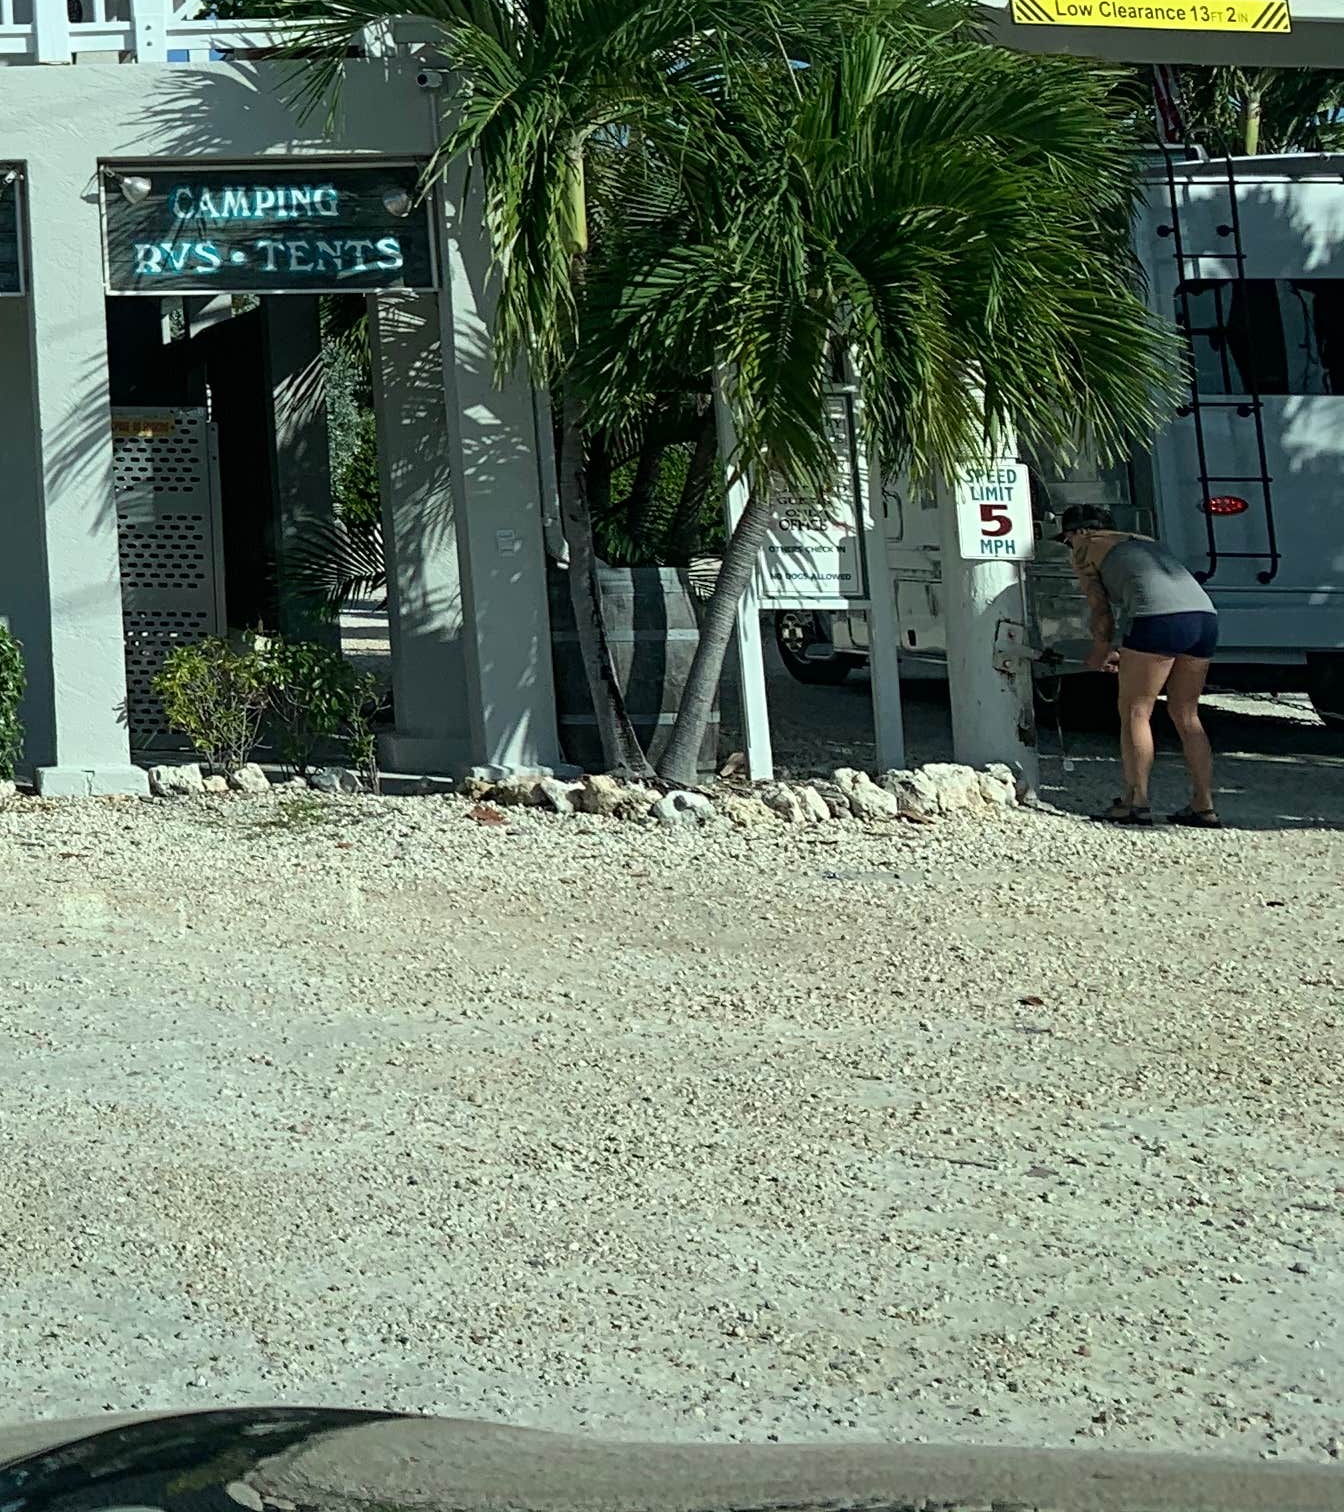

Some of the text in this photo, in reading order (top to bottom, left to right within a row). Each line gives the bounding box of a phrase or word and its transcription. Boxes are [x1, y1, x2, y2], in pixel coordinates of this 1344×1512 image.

[1055, 0, 1093, 17] Low
[1098, 1, 1186, 21] Clearance
[172, 183, 340, 219] CAMPING
[133, 238, 404, 274] RVS TENTS
[965, 468, 1017, 485] SPEED
[970, 486, 1014, 502] LIMIT
[979, 503, 1013, 538] 5
[980, 539, 1016, 555] MPH
